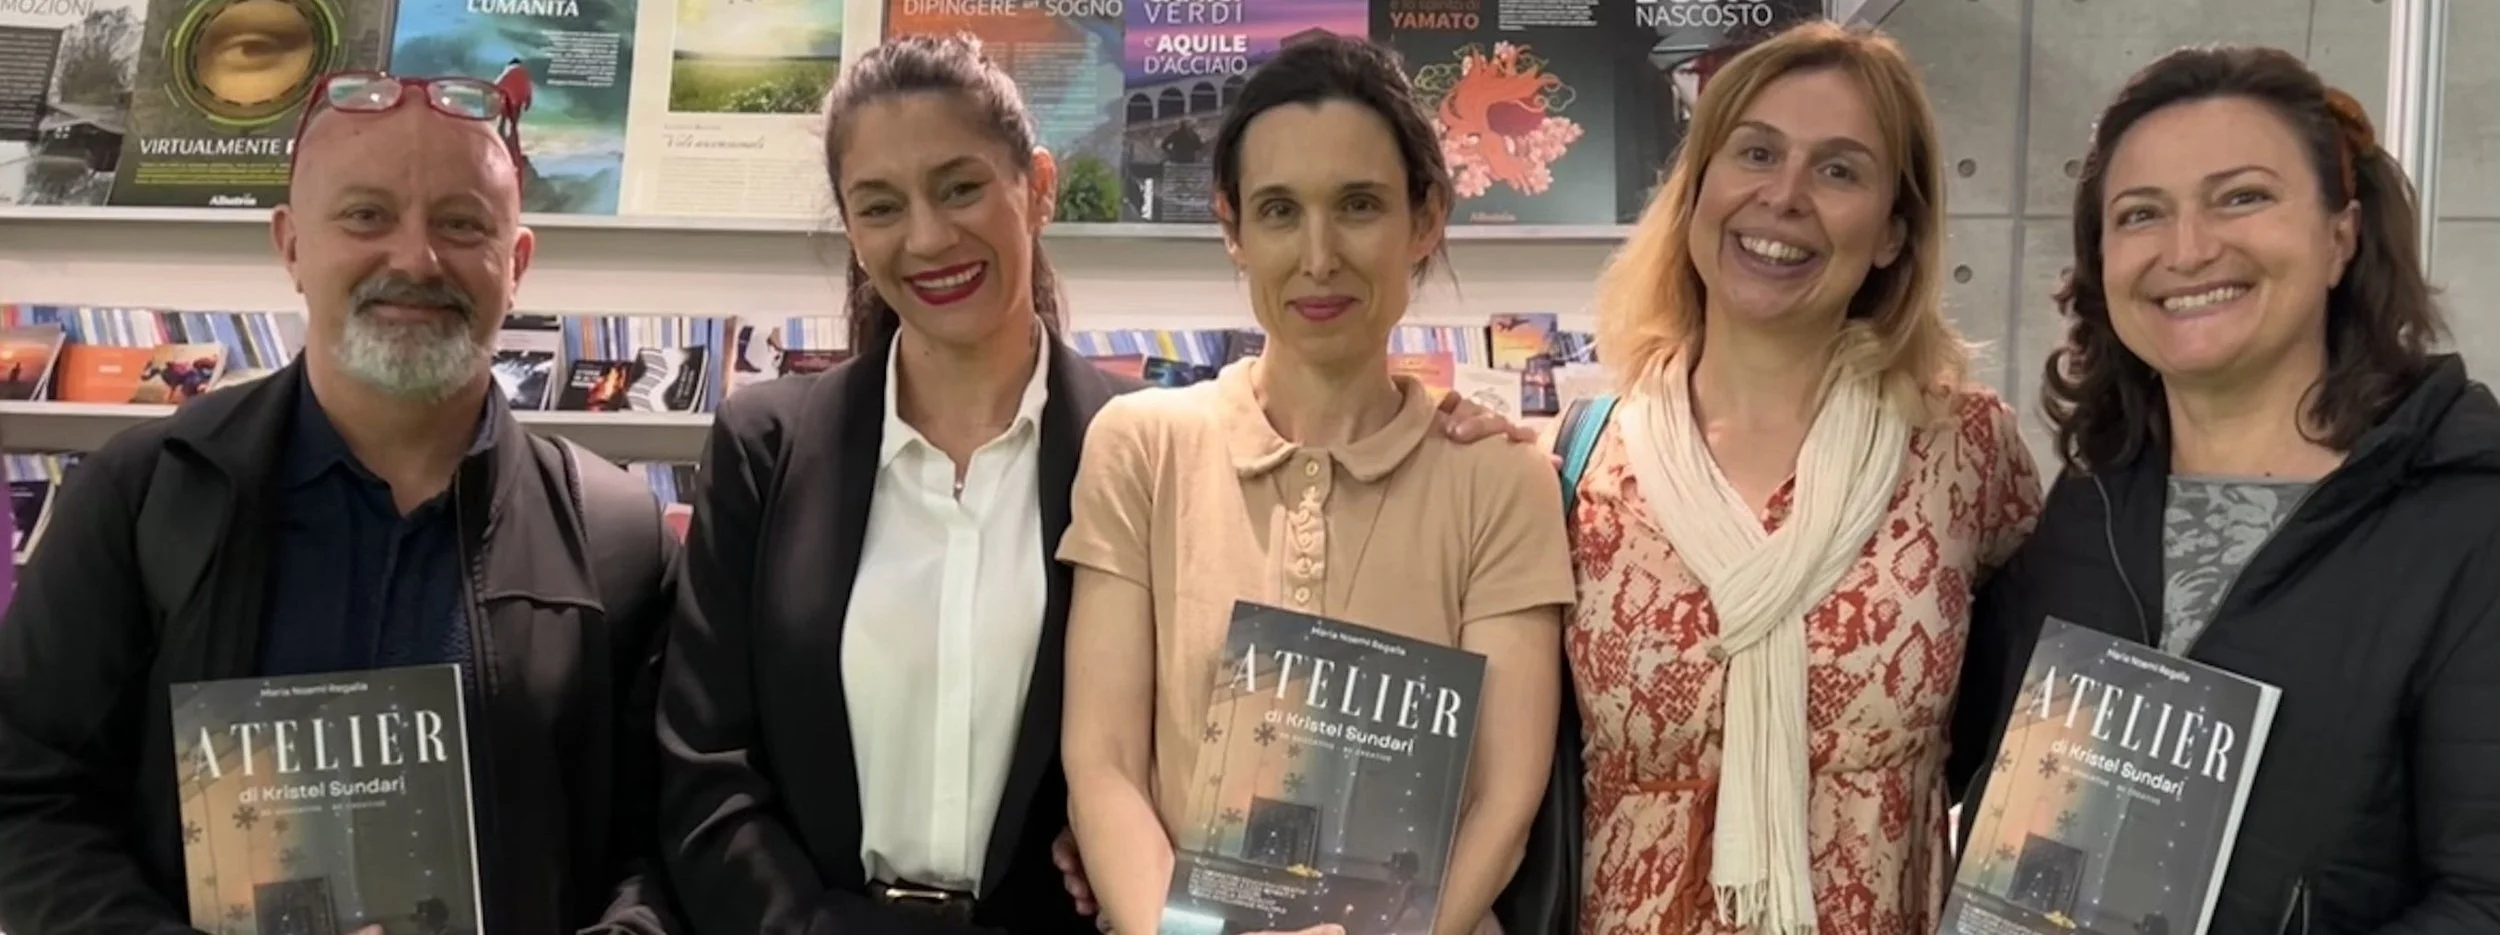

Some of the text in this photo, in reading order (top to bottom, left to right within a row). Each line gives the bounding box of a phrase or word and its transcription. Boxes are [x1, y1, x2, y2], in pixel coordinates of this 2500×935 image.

[903, 0, 1018, 16] DIPINGERE
[1044, 0, 1123, 17] SOGNO
[1143, 2, 1242, 24] VERDI
[1635, 3, 1773, 27] NASCOSTO
[1390, 12, 1480, 30] YAMATO
[1156, 33, 1248, 56] AQUILE
[1143, 55, 1248, 75] D'ACCIAIO
[140, 138, 281, 155] VIRTUALMENTE
[1310, 626, 1338, 640] Maria
[1229, 642, 1462, 738] ATELIER
[1264, 709, 1415, 755] di Kristel Sundari
[2027, 665, 2237, 782] ATELIER
[193, 710, 448, 781] ATELIER
[2051, 738, 2069, 755] di
[2068, 743, 2121, 774] Kristel
[2121, 761, 2185, 800] Sundari
[239, 775, 406, 805] di Kristel Sundari
